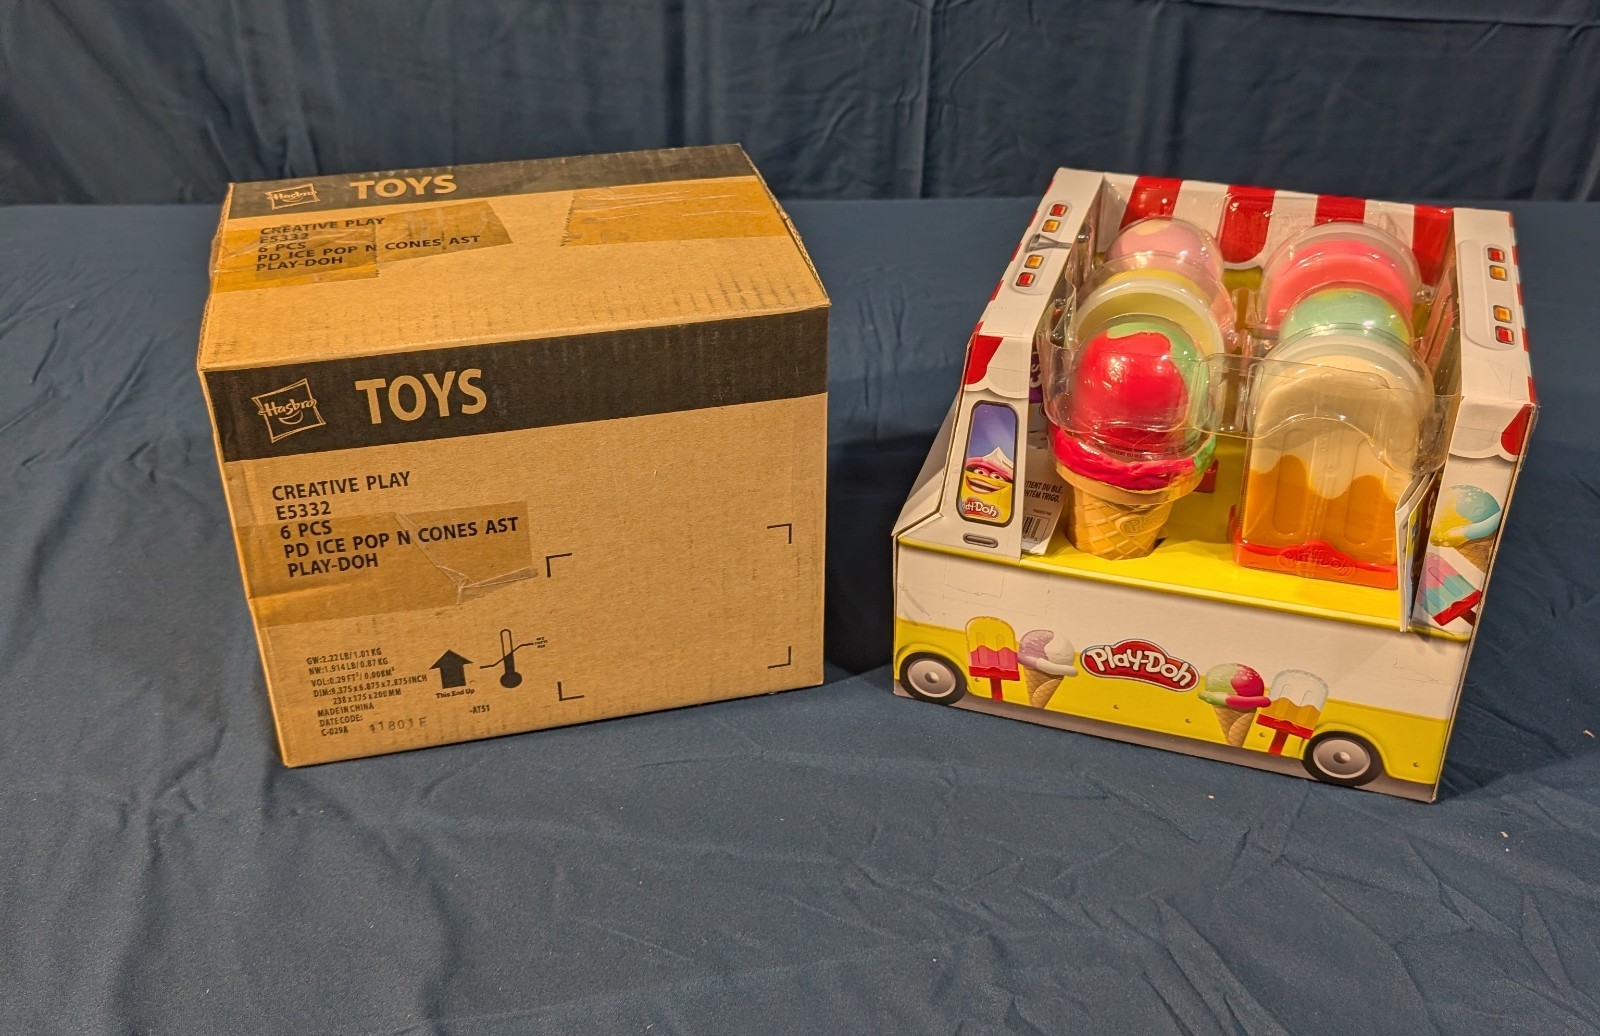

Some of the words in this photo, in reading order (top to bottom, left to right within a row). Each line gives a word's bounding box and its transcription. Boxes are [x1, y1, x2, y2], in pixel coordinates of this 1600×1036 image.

[350, 174, 458, 199] TOYS
[260, 220, 339, 236] CREATIVE
[345, 217, 386, 228] PLAY
[258, 244, 268, 253] 6
[275, 241, 307, 251] PCS
[259, 232, 310, 244] E5332
[257, 253, 281, 263] PD
[288, 249, 316, 259] ICE
[323, 245, 358, 256] POP
[365, 244, 377, 253] N
[384, 238, 442, 250] CONES
[449, 235, 481, 245] AST
[256, 256, 344, 272] PLAY-DOH
[354, 368, 487, 425] TOYS
[258, 398, 317, 417] Hasbro
[272, 478, 360, 501] CREATIVE
[366, 471, 411, 491] PLAY
[1042, 483, 1051, 491] DU
[1041, 492, 1060, 503] TRIGO.
[275, 501, 332, 520] E5332
[280, 525, 291, 540] 6
[298, 520, 332, 537] PCS
[284, 542, 309, 559] PD
[316, 537, 346, 555] ICE
[353, 532, 390, 550] POP
[397, 530, 411, 545] N
[418, 521, 478, 543] CONES
[485, 516, 519, 535] AST
[288, 553, 379, 578] PLAY-DOH
[378, 657, 389, 666] KG
[1085, 645, 1192, 686] Play-Doh
[435, 691, 451, 699] This
[451, 688, 465, 697] End
[465, 688, 475, 696] Up
[317, 707, 340, 717] MADE
[340, 706, 349, 714] IN
[350, 702, 375, 713] CHINA
[319, 717, 340, 727] DATE
[340, 713, 364, 724] CODE:
